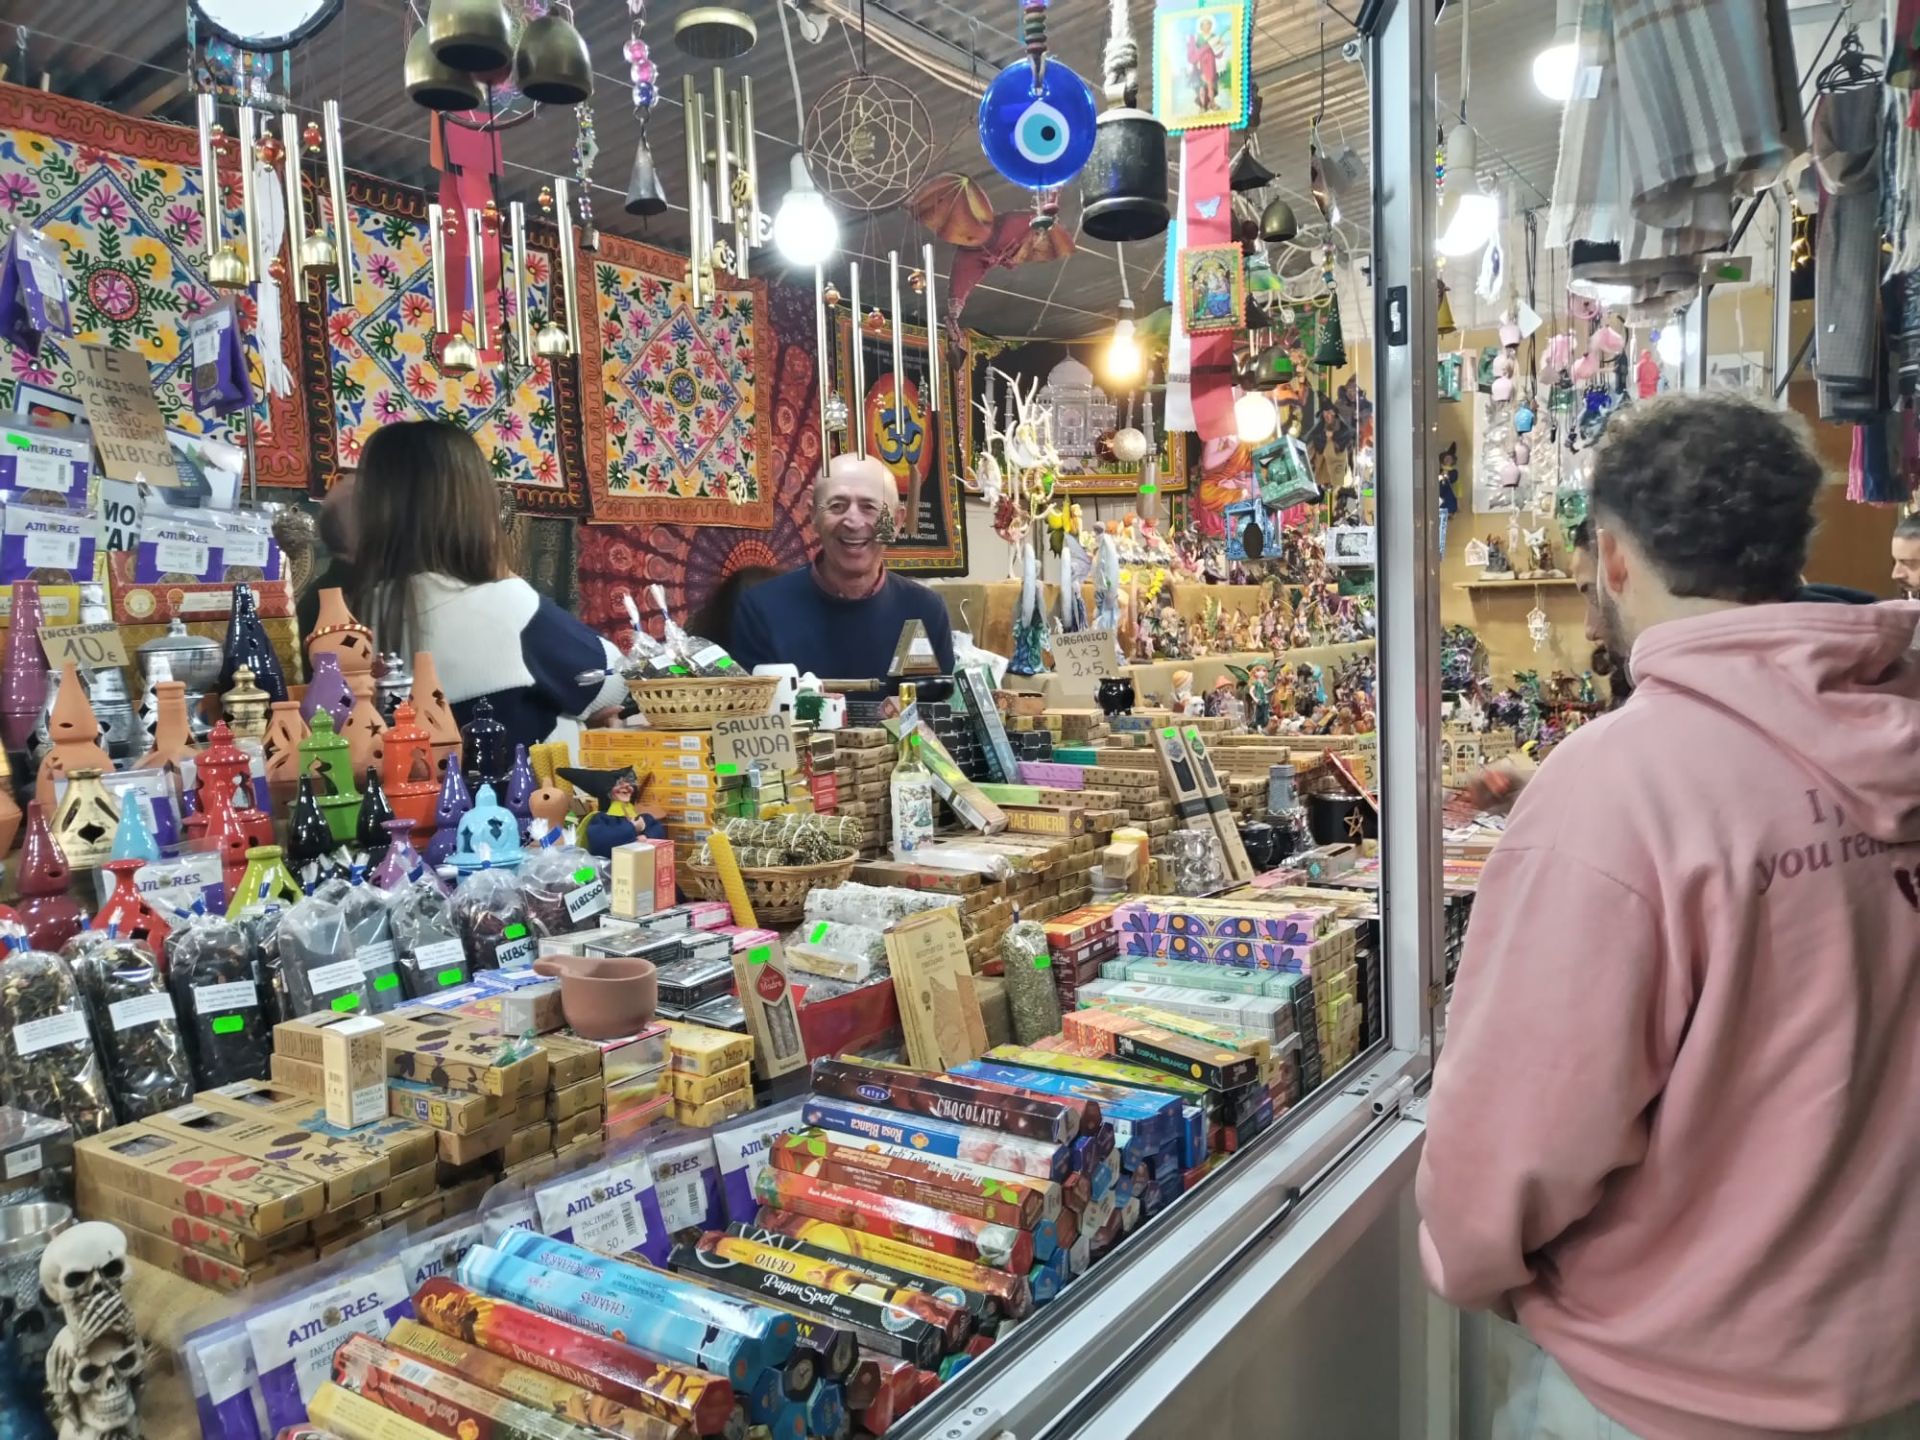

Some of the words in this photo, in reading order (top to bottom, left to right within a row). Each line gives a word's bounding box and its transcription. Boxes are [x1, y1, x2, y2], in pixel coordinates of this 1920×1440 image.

[80, 344, 120, 372] TE
[1056, 632, 1108, 647] ORGANICO
[716, 714, 785, 736] SALVIA
[732, 734, 790, 759] RUDA
[1028, 814, 1067, 832] DINERO
[1755, 841, 1832, 896] you
[569, 884, 603, 914] HIBISCO
[936, 1098, 1001, 1127] CHOCOLATE
[851, 1118, 880, 1138] Blanca
[881, 1125, 904, 1144] Rosa
[754, 1253, 797, 1274] CRAVO
[762, 1272, 803, 1296] Pagan
[798, 1283, 839, 1306] Spell
[512, 1343, 601, 1390] PROSPERIDADE
